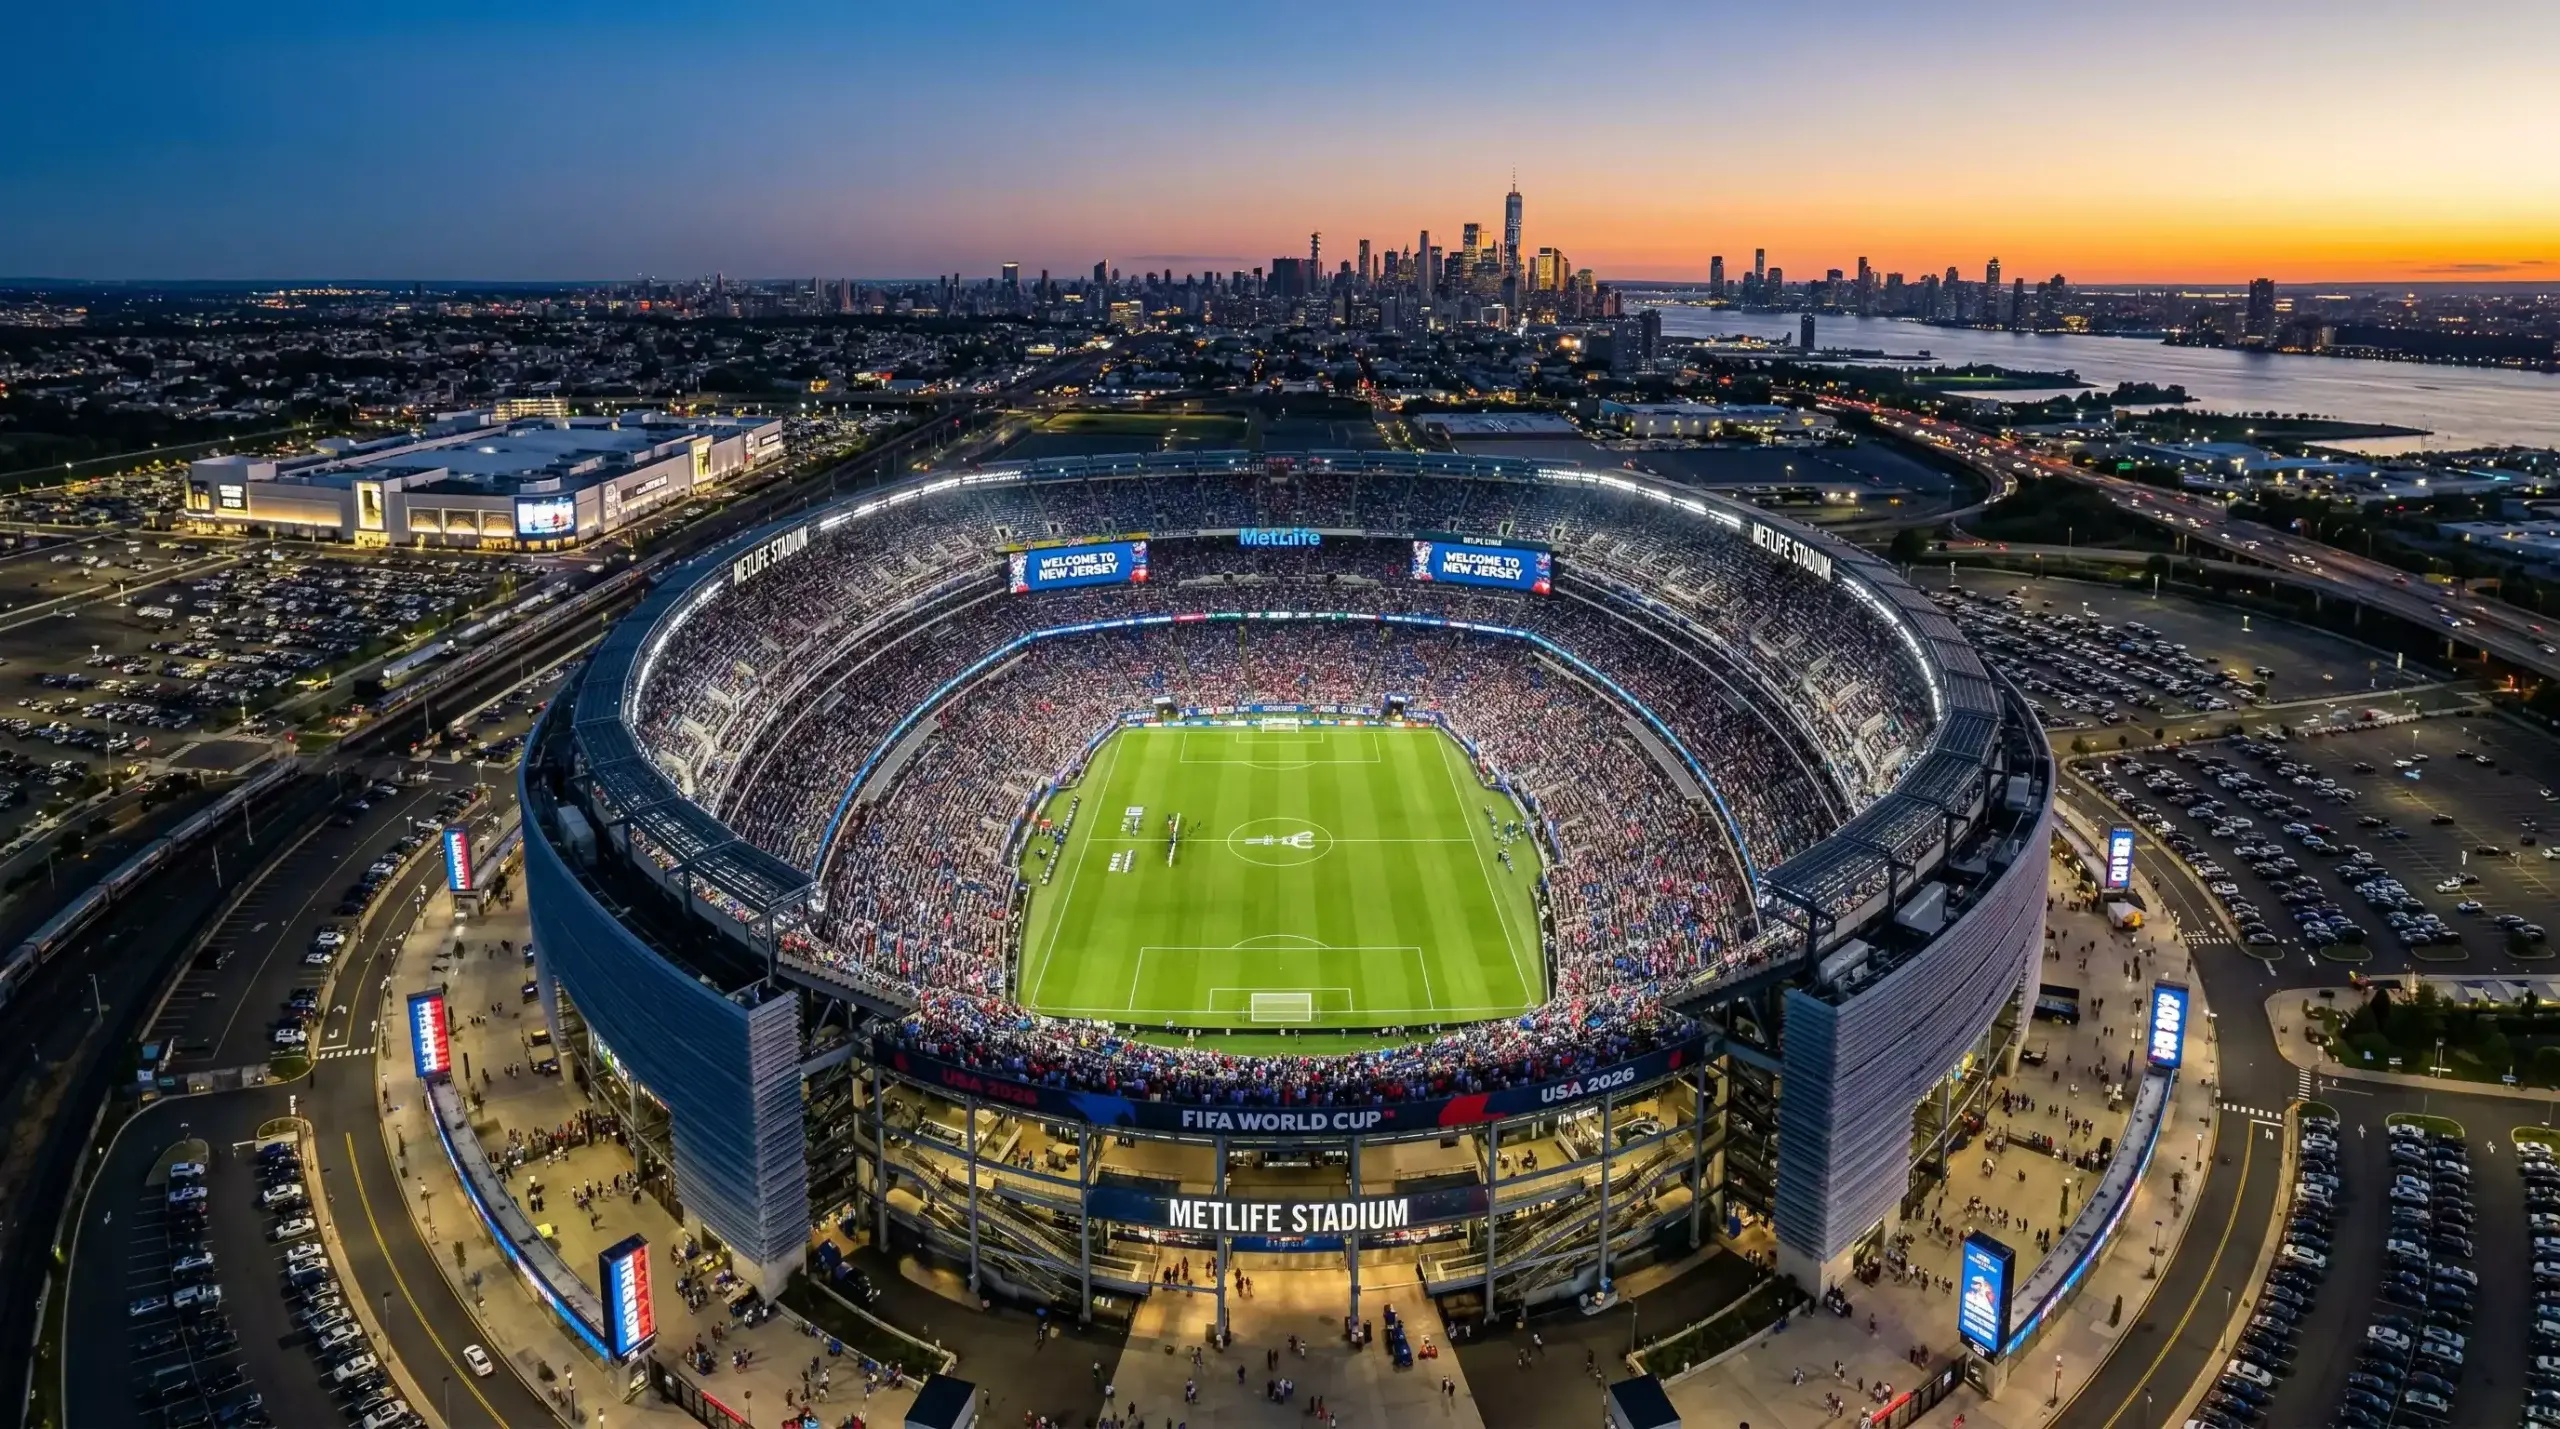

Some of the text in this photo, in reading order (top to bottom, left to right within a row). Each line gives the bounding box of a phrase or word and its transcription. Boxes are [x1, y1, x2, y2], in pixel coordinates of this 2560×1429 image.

[1240, 528, 1321, 546] MetLife
[1041, 552, 1115, 568] WELCOME TO
[1445, 552, 1519, 568] WELCOME TO
[1753, 522, 1832, 582] METLIFE STADIUM
[734, 545, 770, 586] METLIFE
[1039, 562, 1119, 581] NEW JERSEY
[1443, 562, 1523, 580] NEW JERSEY
[941, 1068, 983, 1092] USA
[1541, 1067, 1635, 1103] USA 2026
[1182, 1110, 1234, 1130] FIFA
[1238, 1113, 1328, 1131] WORLD
[1333, 1111, 1382, 1129] CUP
[1169, 1198, 1408, 1232] METLIFE STADIUM
